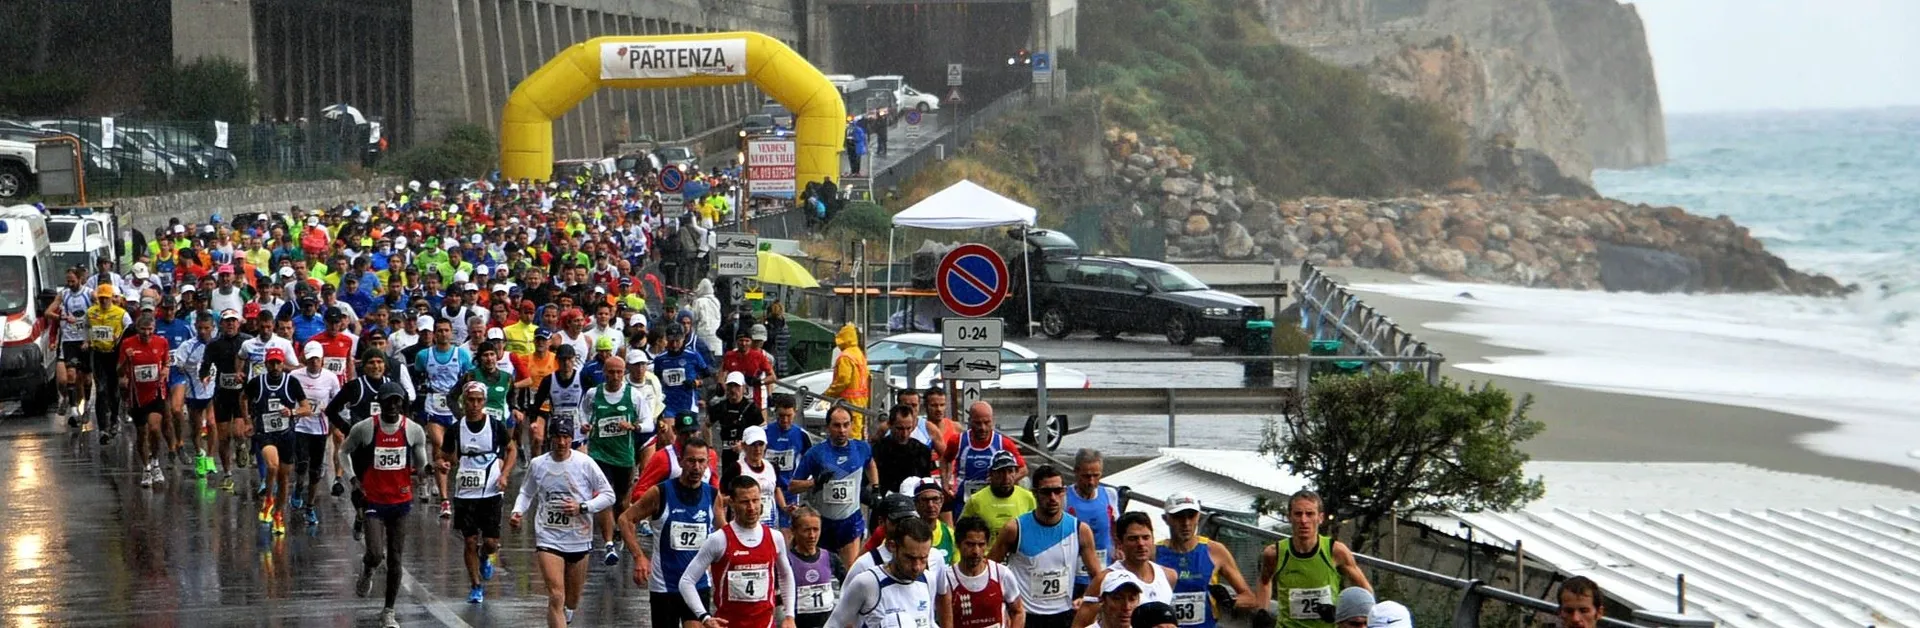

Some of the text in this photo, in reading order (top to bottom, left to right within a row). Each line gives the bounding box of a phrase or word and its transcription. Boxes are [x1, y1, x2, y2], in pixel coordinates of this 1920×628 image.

[629, 47, 727, 70] PARTENZA
[757, 143, 787, 153] VENDESI
[750, 153, 795, 164] NUOVE VILLE
[720, 261, 743, 269] eccetto
[958, 326, 987, 340] 0-24
[668, 373, 681, 383] 197
[379, 454, 401, 466] 354
[460, 475, 480, 487] 260
[832, 487, 847, 500] 39
[547, 511, 570, 525] 326
[680, 531, 697, 546] 92
[745, 579, 755, 596] 4
[1042, 578, 1060, 595] 29
[811, 592, 824, 608] 11
[1301, 598, 1321, 614] 25
[1175, 603, 1195, 620] 53
